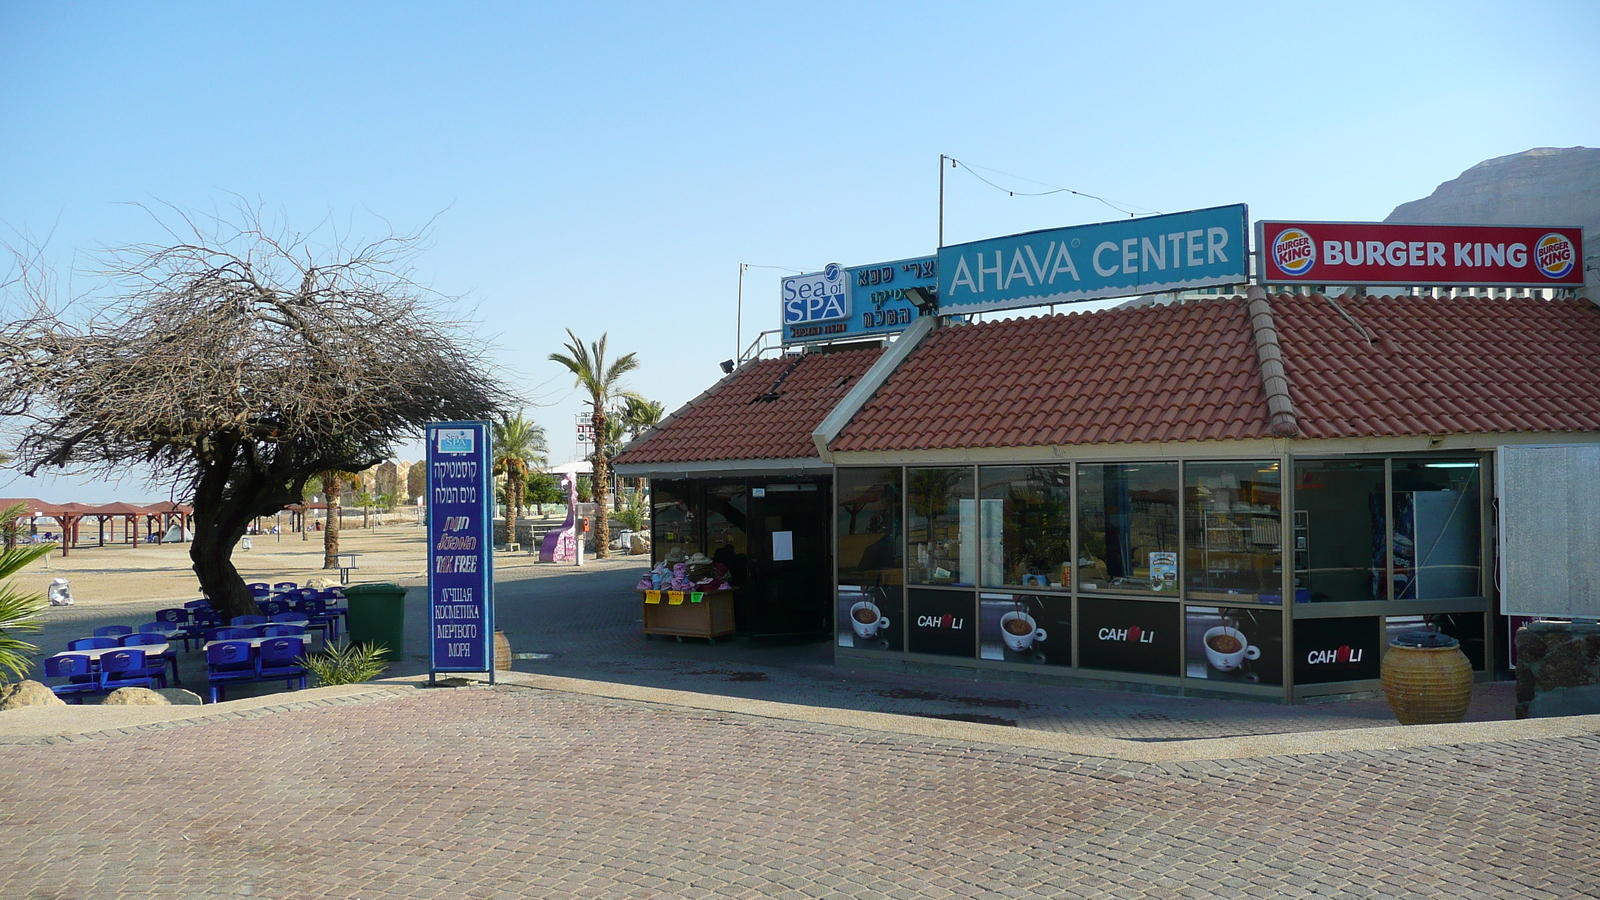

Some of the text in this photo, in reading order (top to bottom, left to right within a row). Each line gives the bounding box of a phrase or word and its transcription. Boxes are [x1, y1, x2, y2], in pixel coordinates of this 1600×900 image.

[1277, 237, 1309, 254] BURGER
[1323, 240, 1528, 268] BURGER KING
[1539, 241, 1568, 257] BURGER
[949, 226, 1229, 296] AHAVA CENTER
[1279, 245, 1311, 265] KING
[1540, 249, 1571, 269] KING
[784, 279, 843, 302] Sea of
[786, 295, 846, 323] SPA
[436, 555, 477, 573] TAX FREE
[441, 588, 472, 602] ЛУЧШАЯ
[435, 605, 479, 619] КОСМЕТИКА
[437, 624, 477, 639] МЕРТВОГО
[448, 643, 470, 657] МОРЯ
